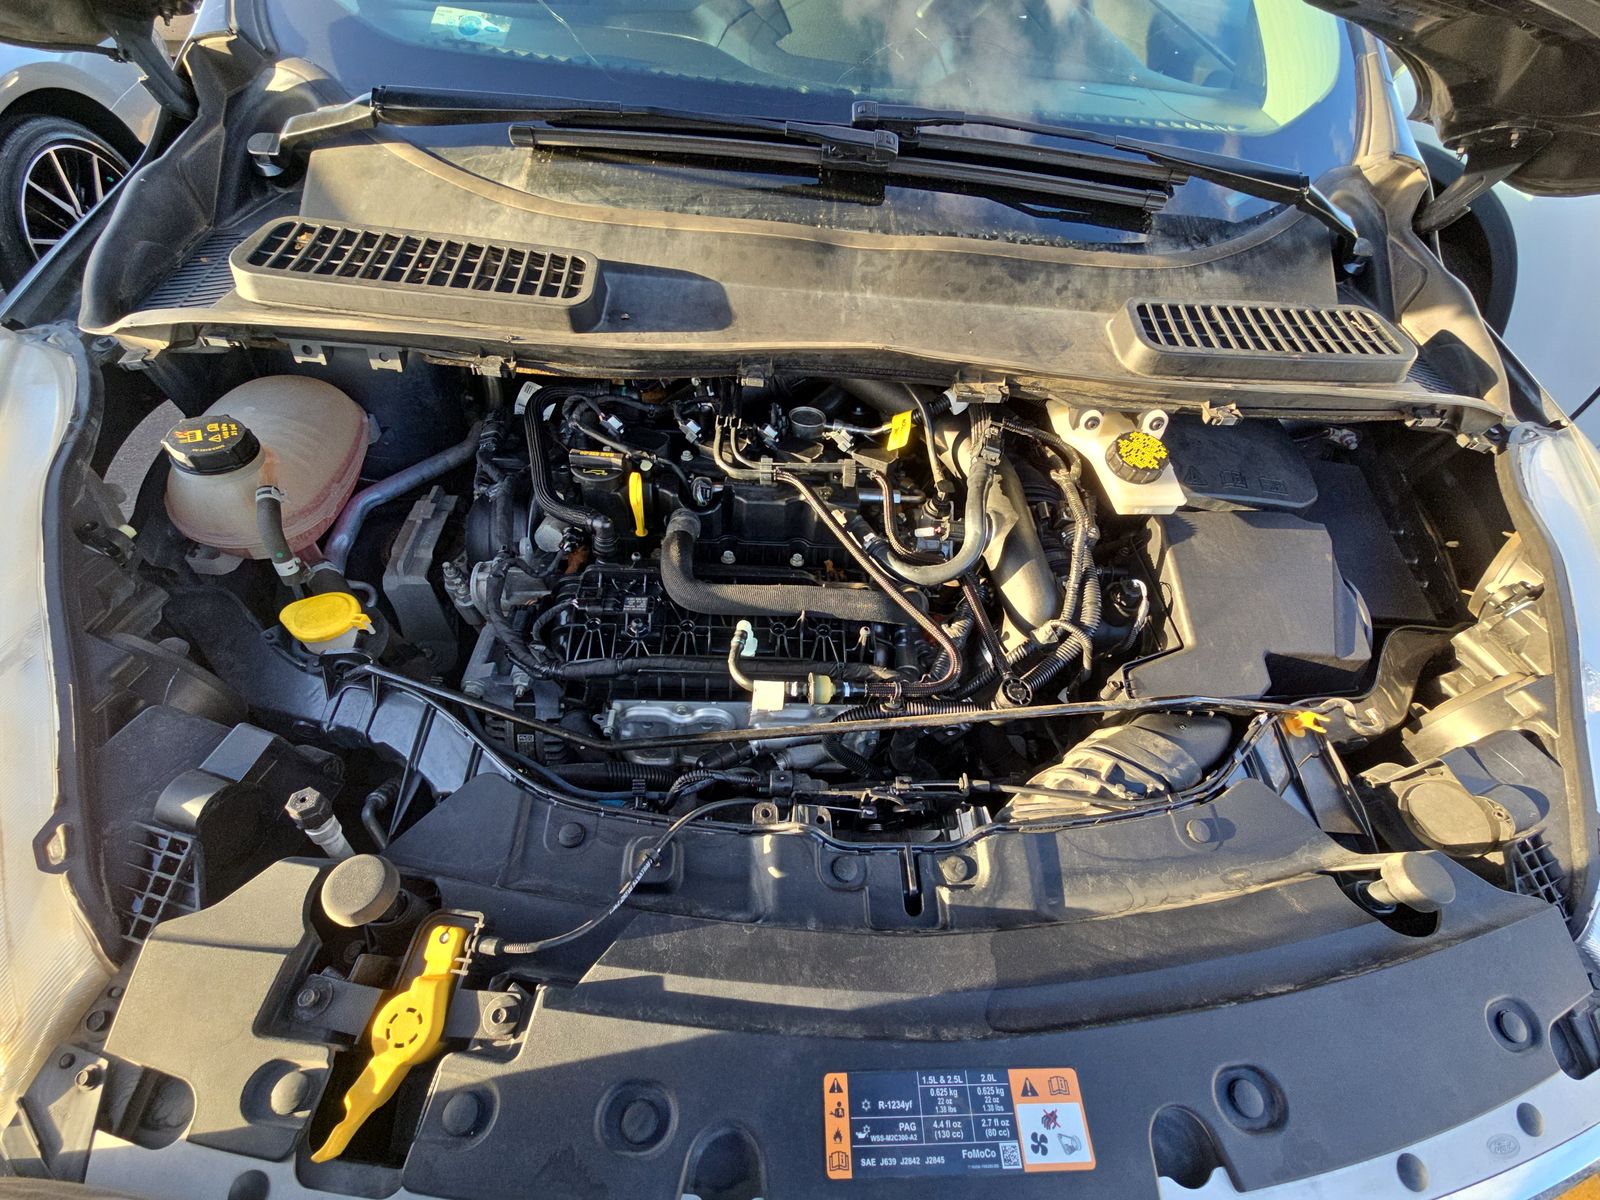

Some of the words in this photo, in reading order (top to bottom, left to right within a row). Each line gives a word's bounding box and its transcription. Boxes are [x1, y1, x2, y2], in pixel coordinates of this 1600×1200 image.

[922, 1075, 938, 1084] 1.5L
[939, 1075, 946, 1084] &
[947, 1075, 964, 1084] 2.5L
[980, 1073, 997, 1082] 2.0L
[930, 1088, 948, 1096] 0.625
[949, 1088, 958, 1098] kg
[976, 1086, 995, 1095] 0.625
[995, 1086, 1005, 1096] kg
[878, 1100, 913, 1111] R-1234yf
[899, 1122, 917, 1131] PAG
[933, 1120, 944, 1128] 4.4
[945, 1120, 951, 1128] fl
[981, 1118, 992, 1127] 2.7
[993, 1118, 999, 1126] fl
[934, 1129, 950, 1140] (130
[951, 1129, 964, 1139] cc)
[985, 1128, 997, 1138] (80
[998, 1128, 1010, 1138] cc)
[961, 1148, 997, 1159] FoMoCo
[861, 1158, 876, 1167] SAE
[880, 1157, 897, 1166] J639
[925, 1155, 945, 1165] J2845
